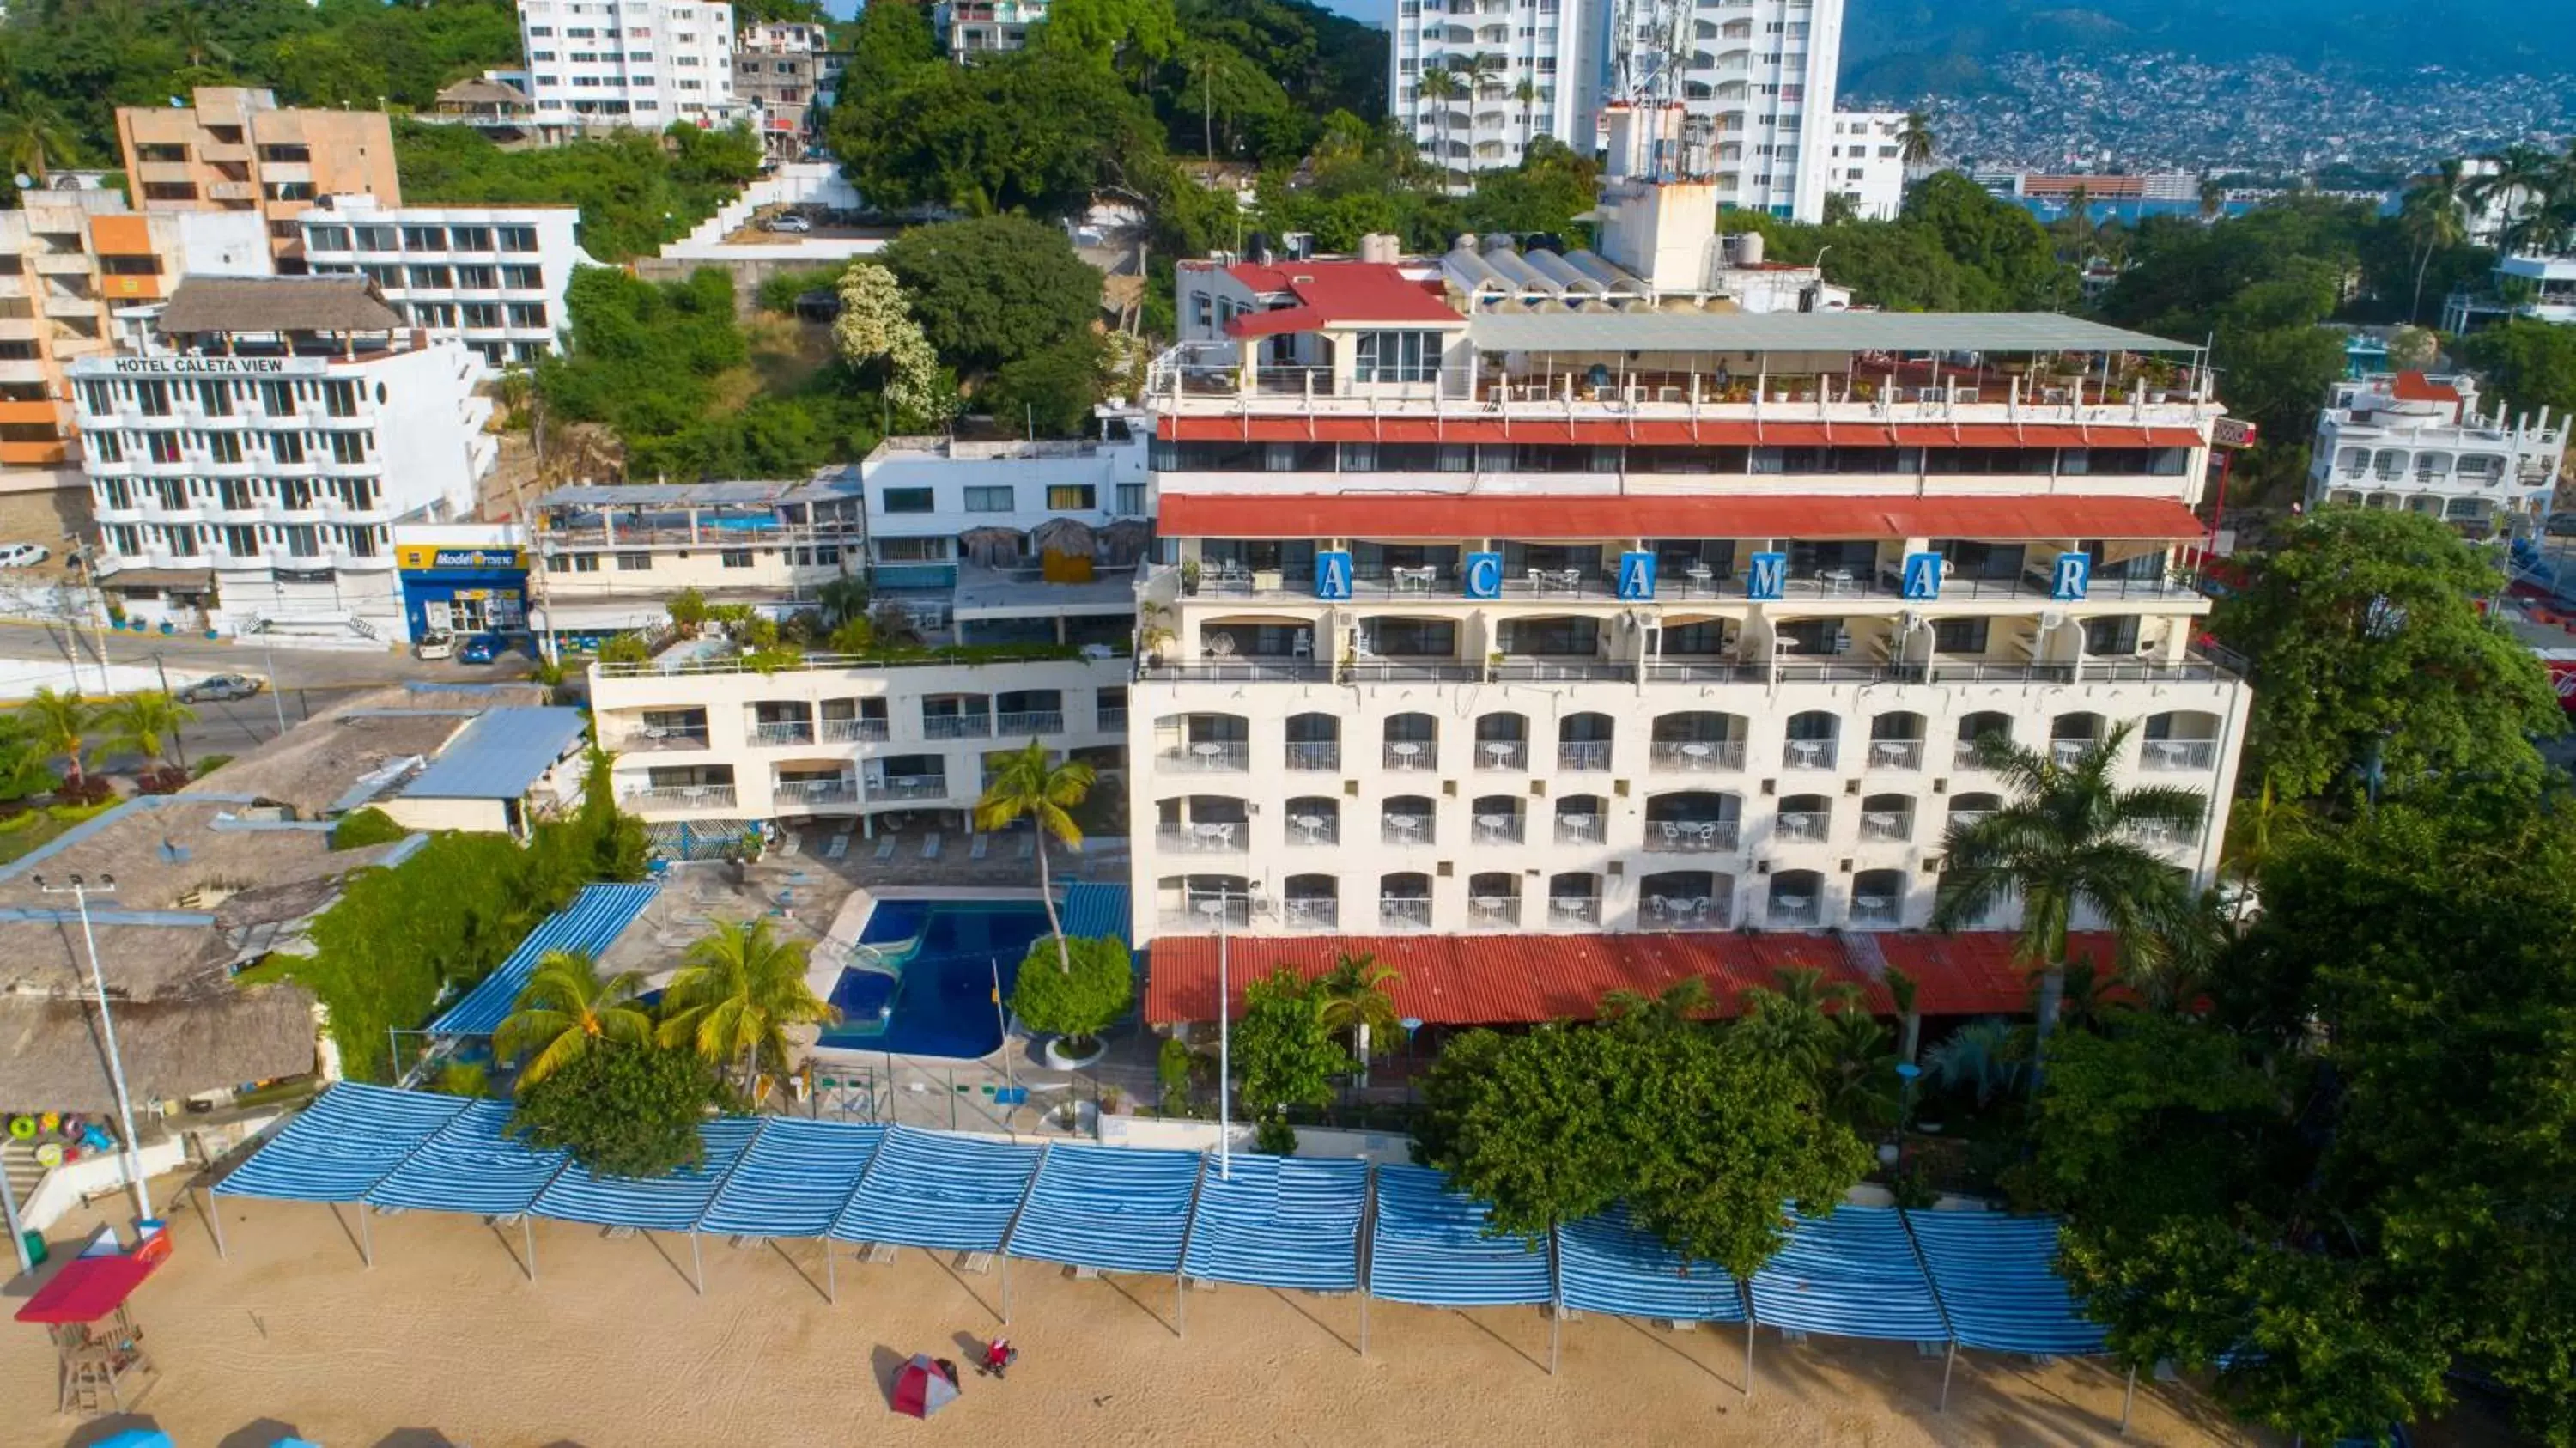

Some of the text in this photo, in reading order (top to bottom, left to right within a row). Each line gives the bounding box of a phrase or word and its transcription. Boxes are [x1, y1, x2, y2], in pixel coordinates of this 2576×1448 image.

[115, 359, 283, 372] HOTEL CALETA VIEW
